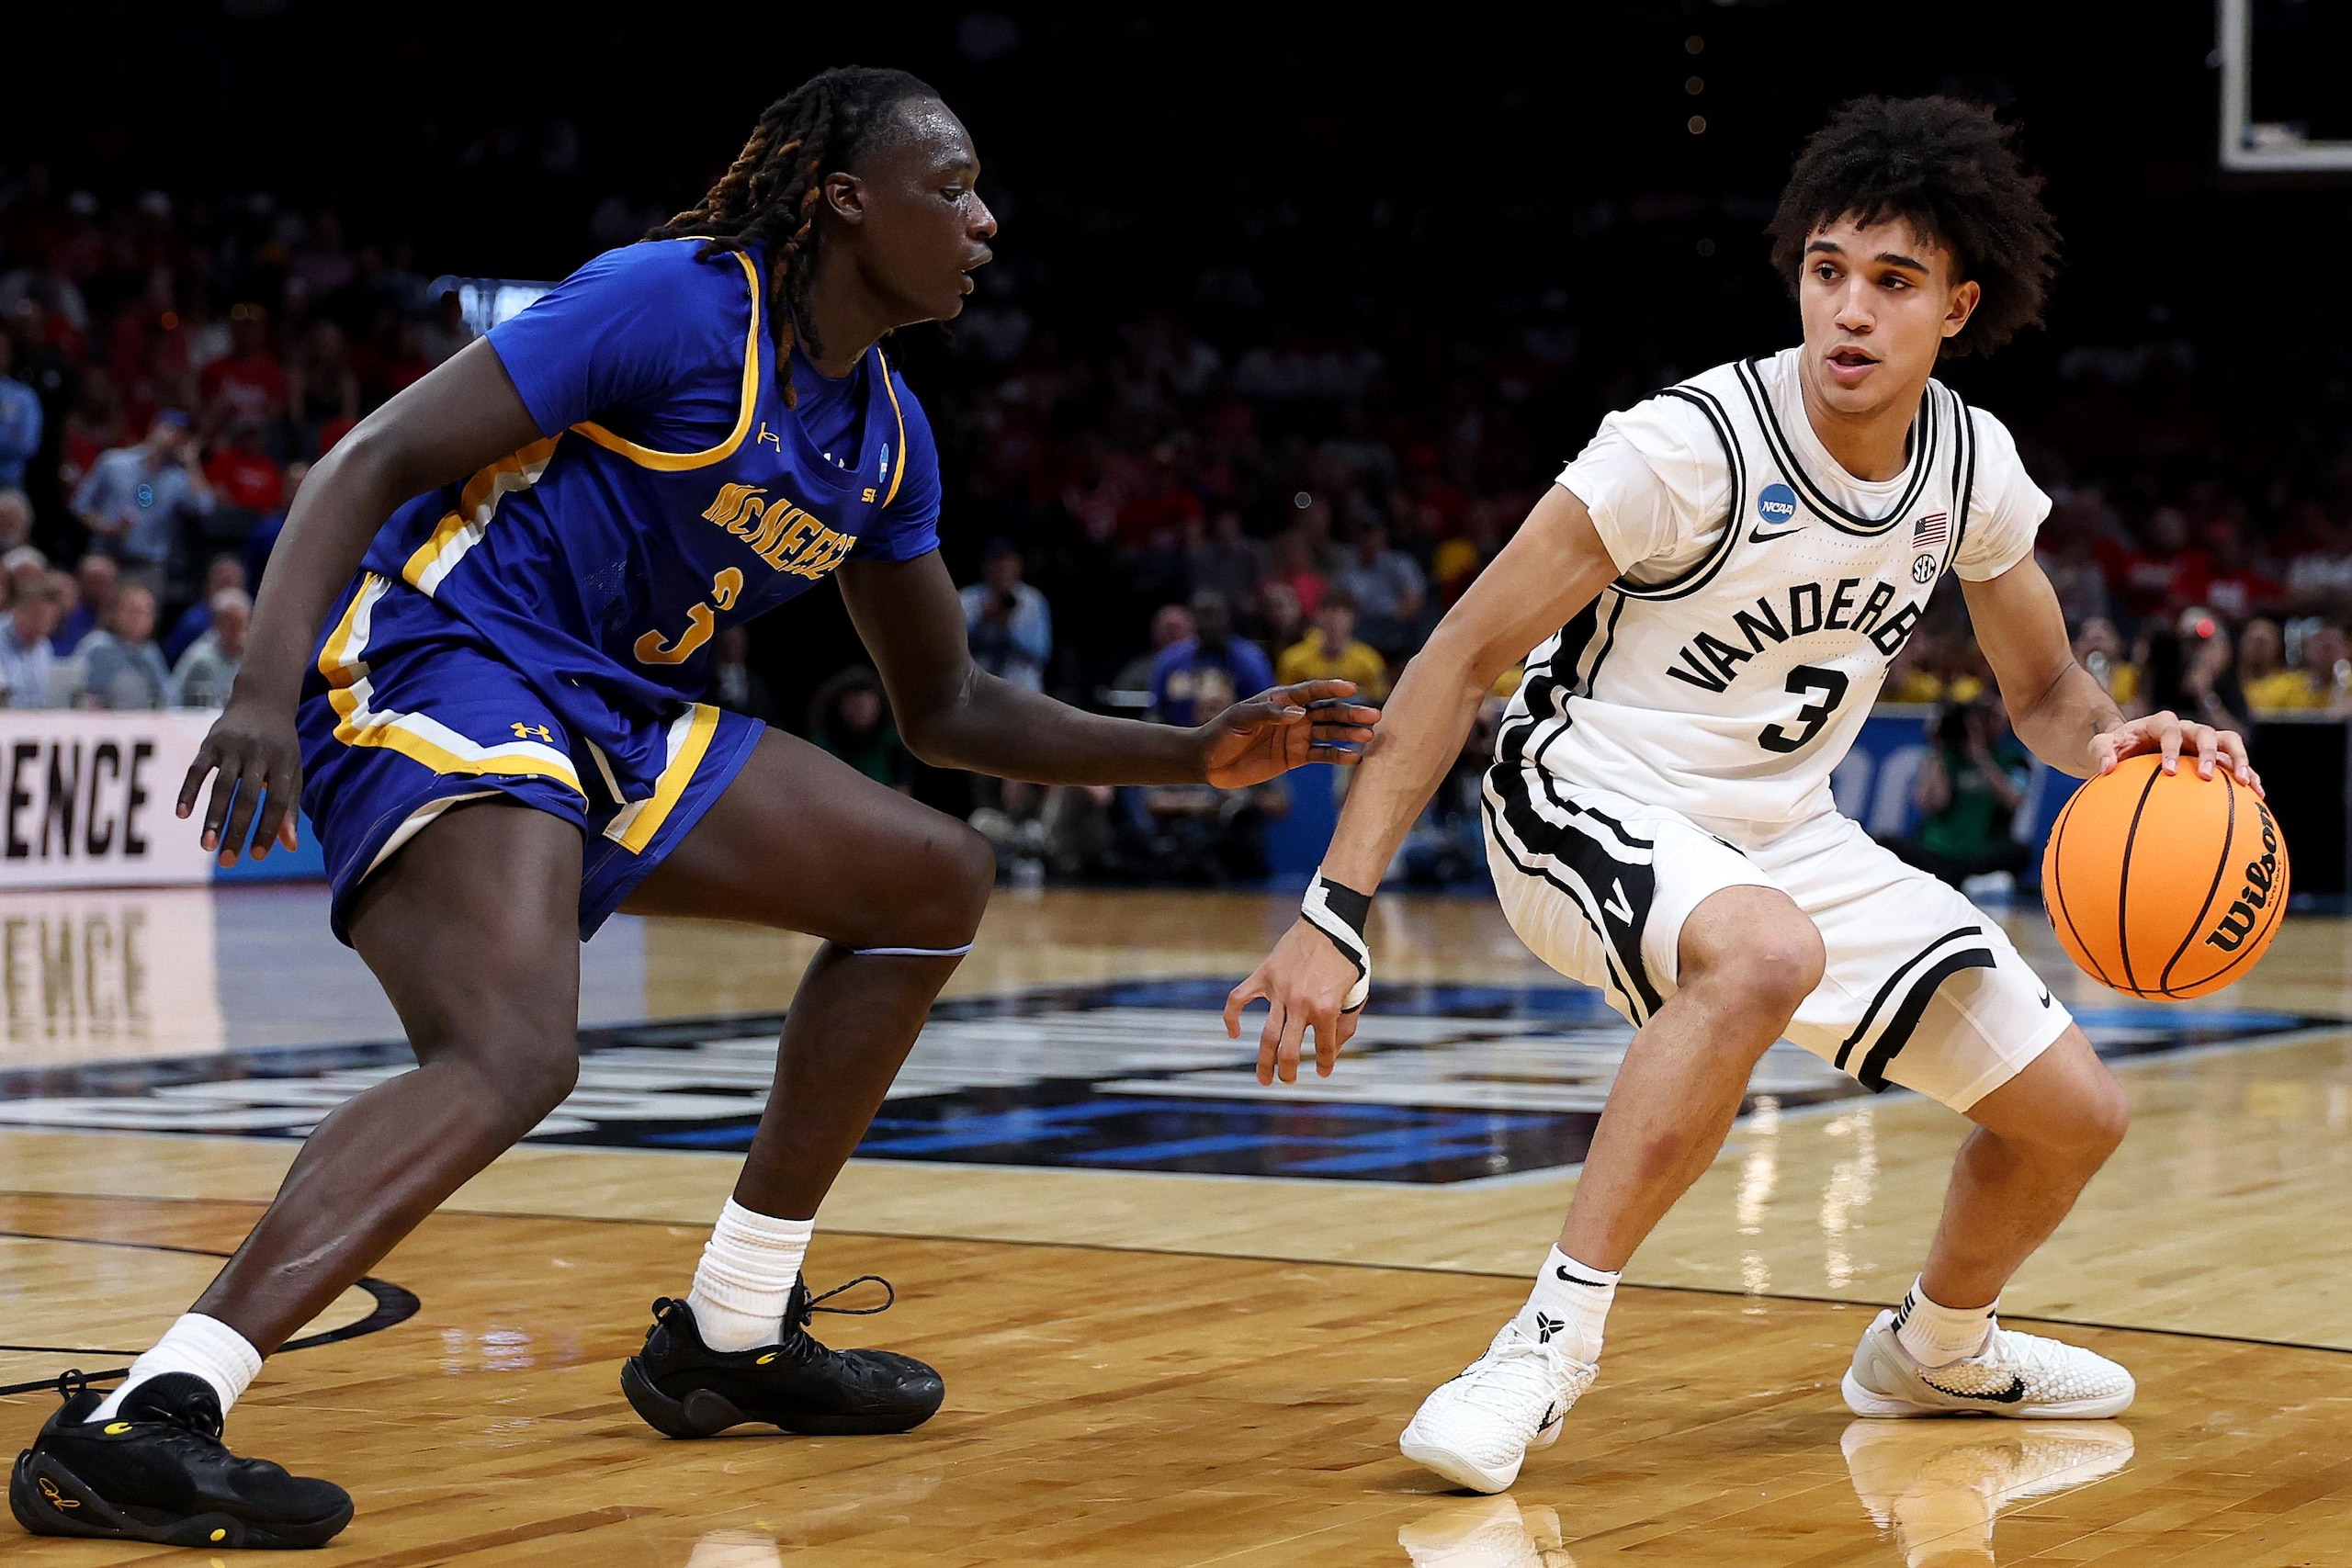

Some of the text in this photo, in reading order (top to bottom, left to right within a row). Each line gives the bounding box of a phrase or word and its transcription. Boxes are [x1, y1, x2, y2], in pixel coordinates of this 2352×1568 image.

[1761, 501, 1794, 515] NCAA
[1913, 555, 1936, 582] SEC
[633, 566, 743, 664] 3
[1666, 577, 1922, 694] VANDERB
[1758, 664, 1849, 753] 3
[1603, 876, 1634, 928] V
[2205, 801, 2278, 953] Wilson
